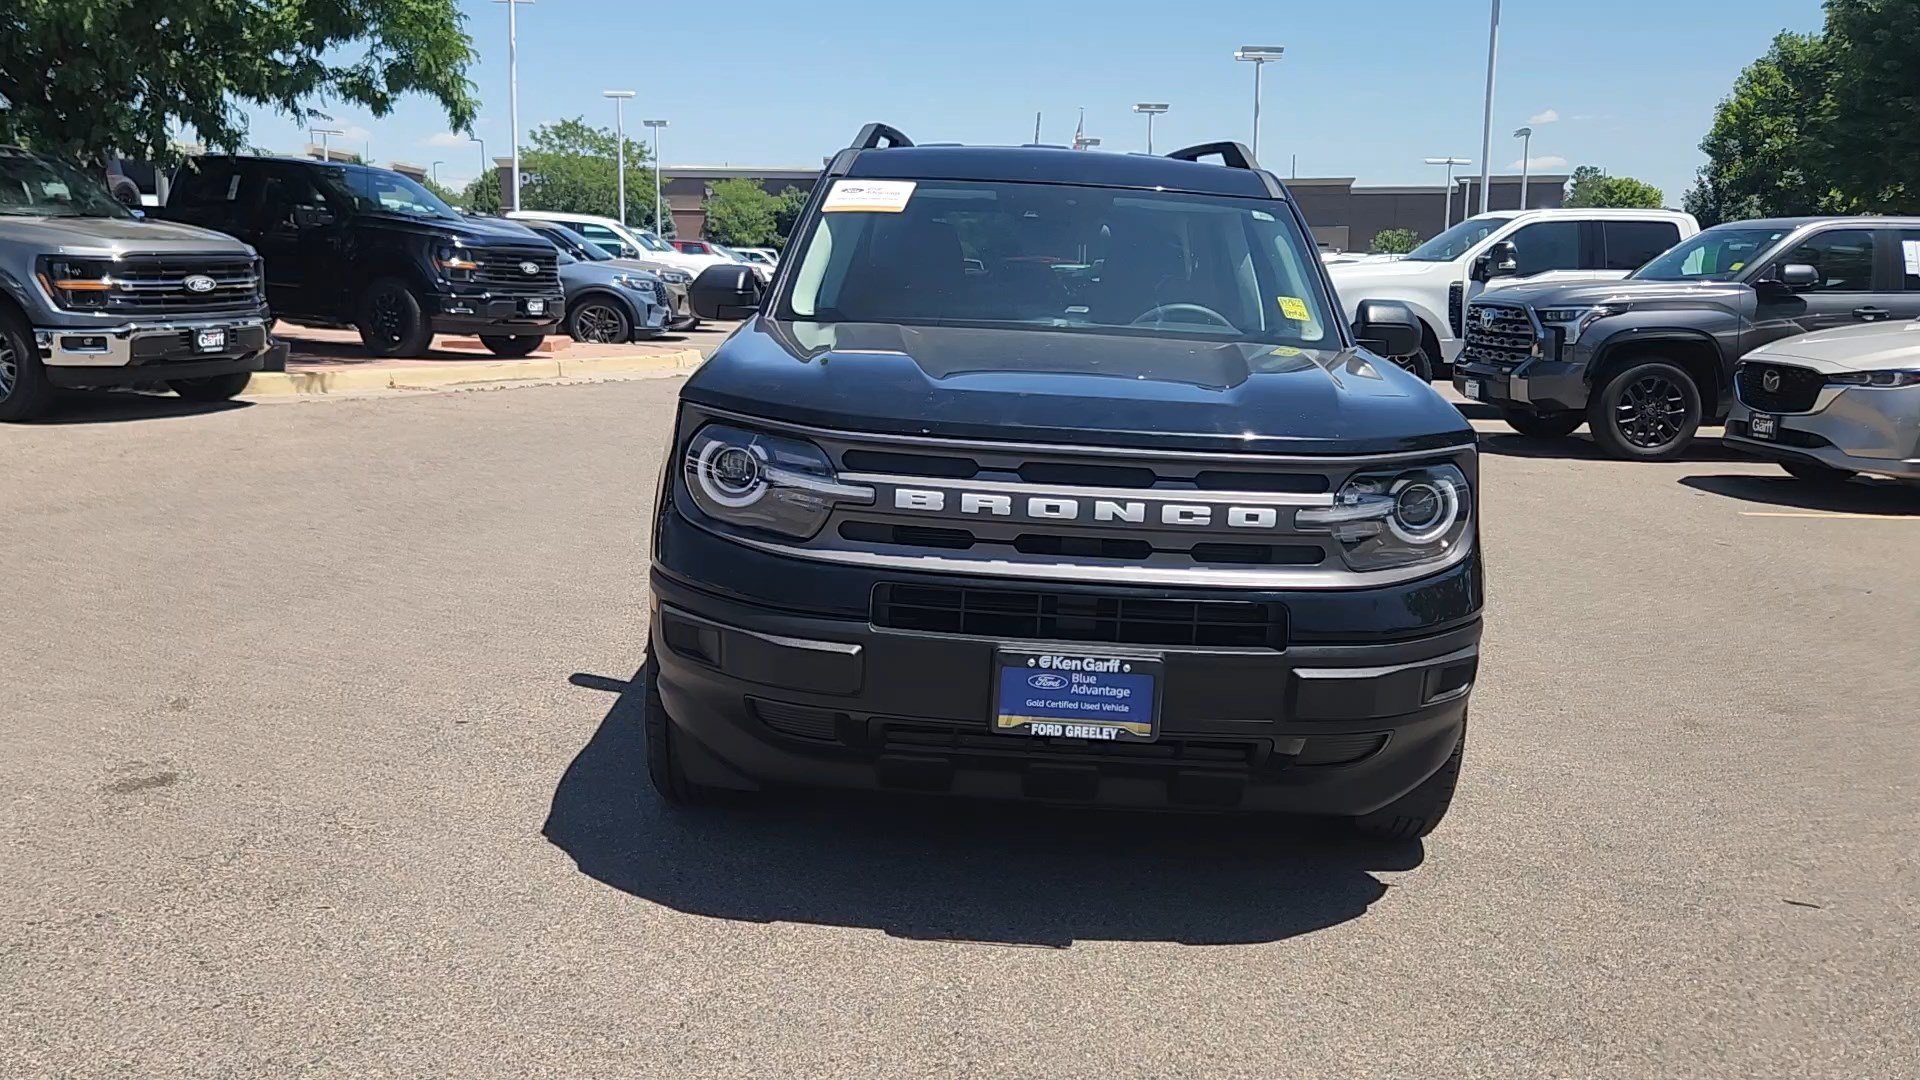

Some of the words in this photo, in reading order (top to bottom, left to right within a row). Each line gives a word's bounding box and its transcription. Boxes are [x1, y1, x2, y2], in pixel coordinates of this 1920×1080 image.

[895, 488, 1277, 528] BRONCO
[1052, 656, 1081, 671] Ken
[1082, 658, 1121, 673] Garff
[1035, 675, 1061, 688] Ford
[1071, 673, 1097, 684] Blue
[1070, 684, 1131, 699] Advantage
[1026, 699, 1045, 708] Gold
[1046, 700, 1079, 710] Certified
[1080, 702, 1101, 711] Used
[1101, 703, 1130, 713] Vehicle
[1031, 723, 1063, 737] FORD
[1065, 725, 1119, 740] GREELEY
